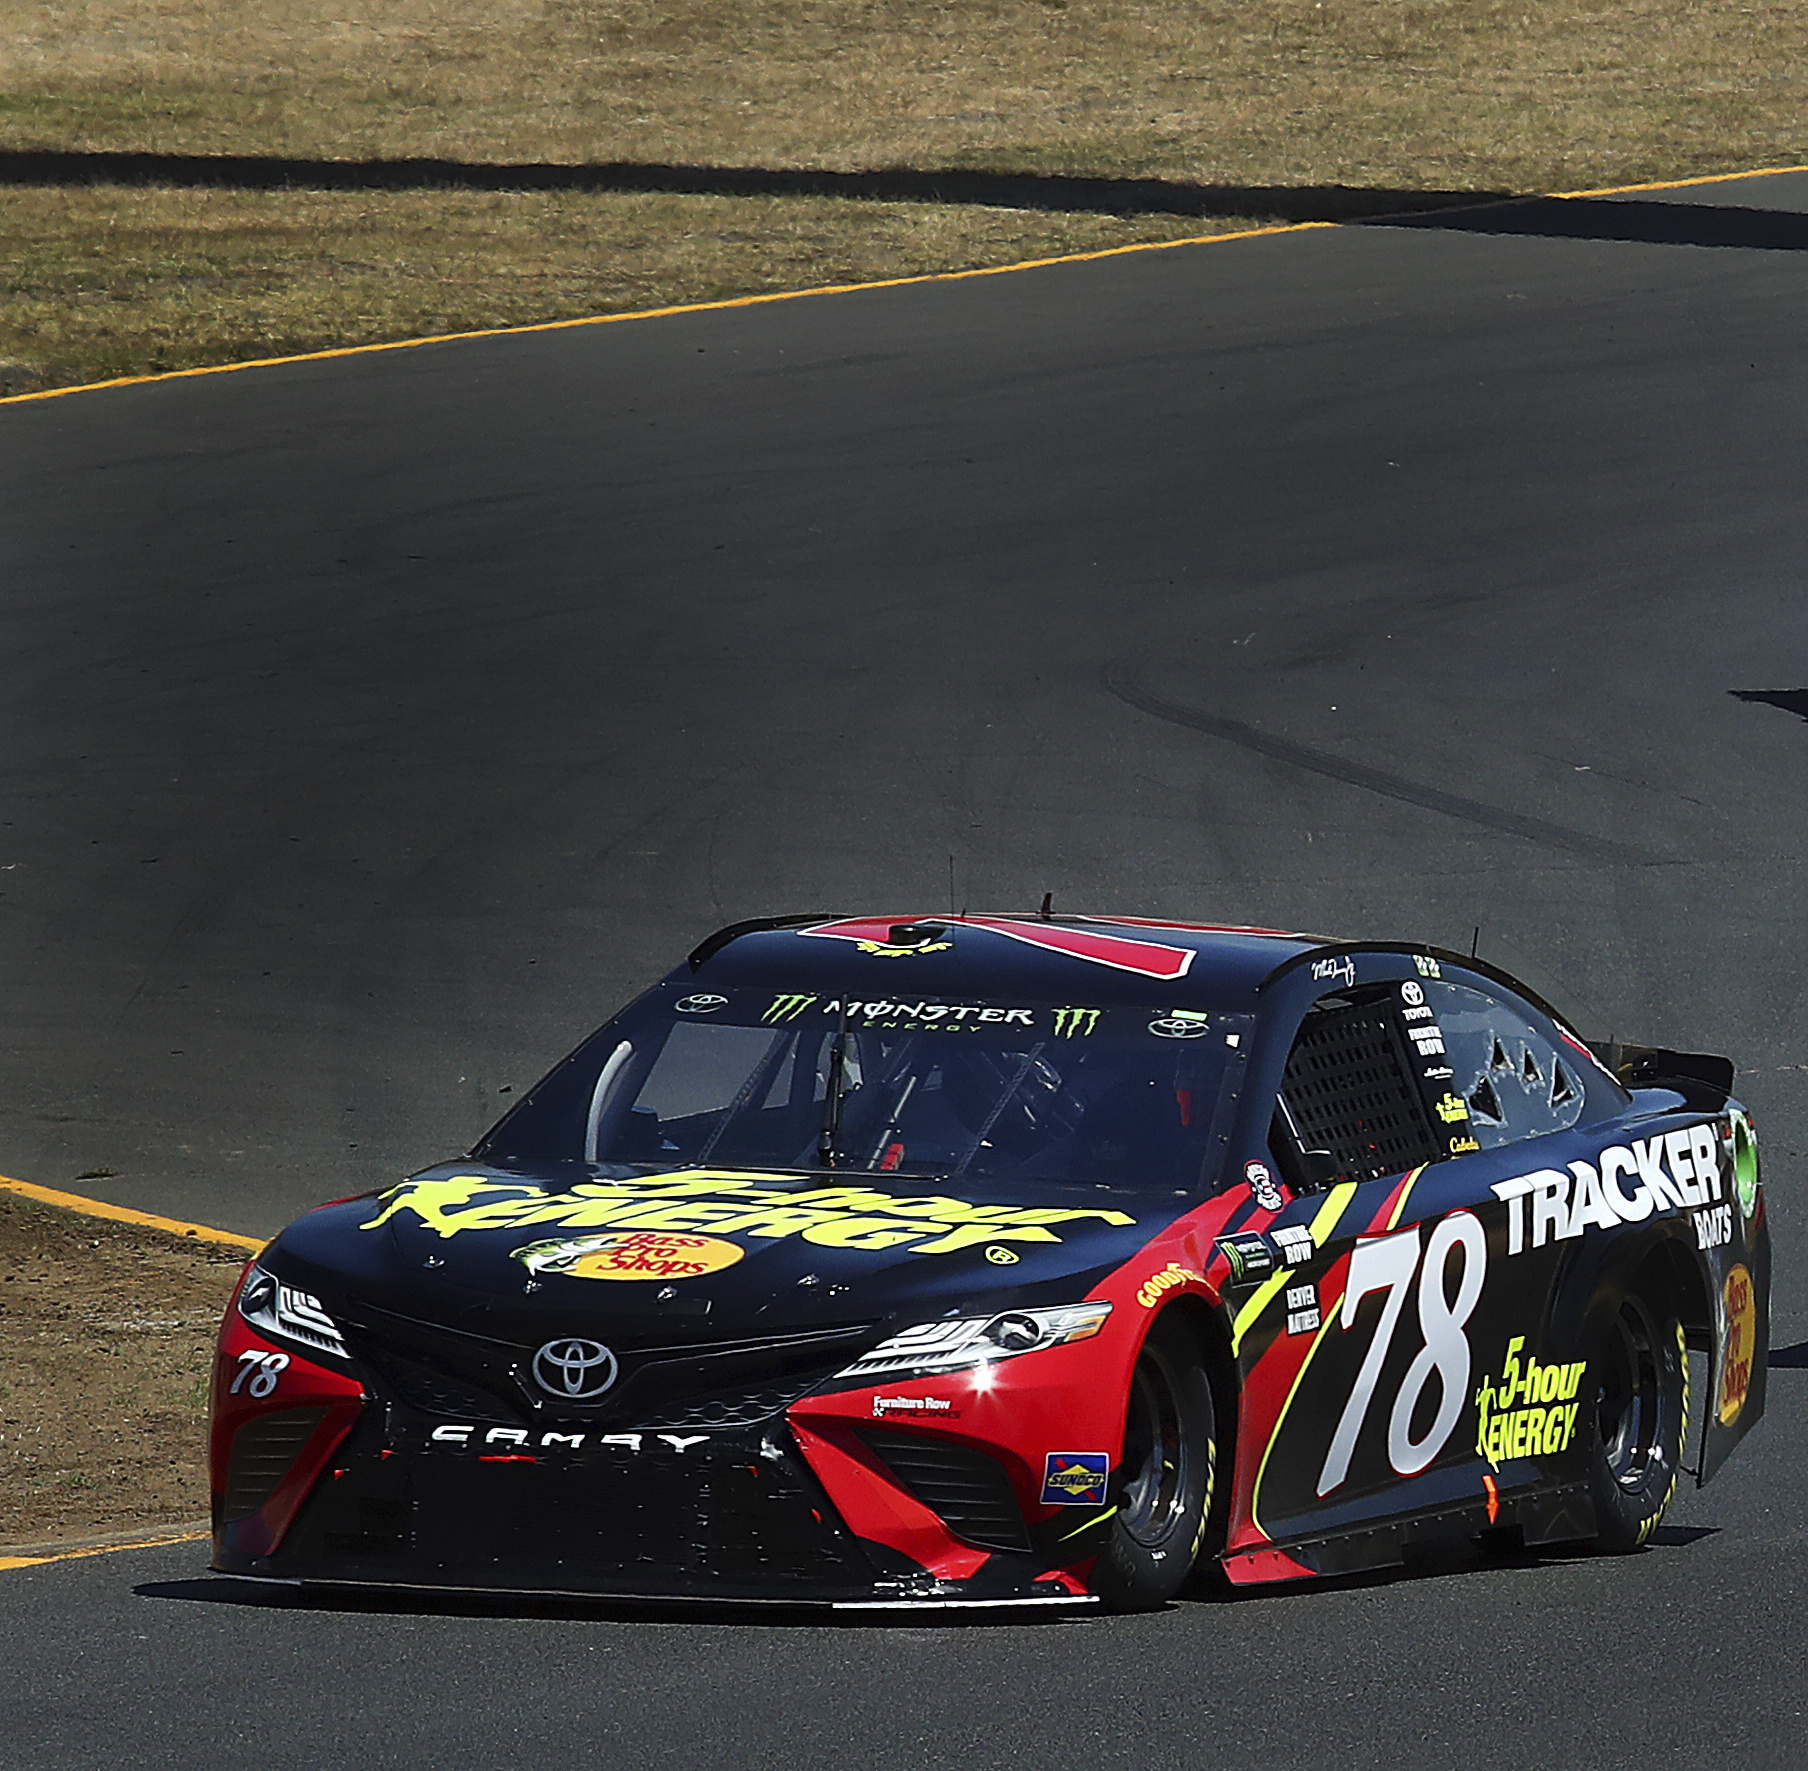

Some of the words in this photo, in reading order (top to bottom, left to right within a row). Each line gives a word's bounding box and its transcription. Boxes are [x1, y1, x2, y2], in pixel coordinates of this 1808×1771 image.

[1490, 1123, 1722, 1255] TRACKER
[618, 1233, 709, 1249] Bass
[1692, 1204, 1732, 1250] BOATS
[594, 1256, 708, 1275] Shops
[1284, 1242, 1312, 1264] ROW
[1316, 1207, 1487, 1498] 78
[228, 1351, 291, 1398] 78
[1500, 1336, 1586, 1409] 5-hour
[873, 1396, 924, 1409] Furniture
[925, 1398, 950, 1410] Row
[432, 1425, 711, 1453] CAMRY
[1489, 1403, 1580, 1461] ENERGY
[1049, 1473, 1102, 1487] SUNOCO
